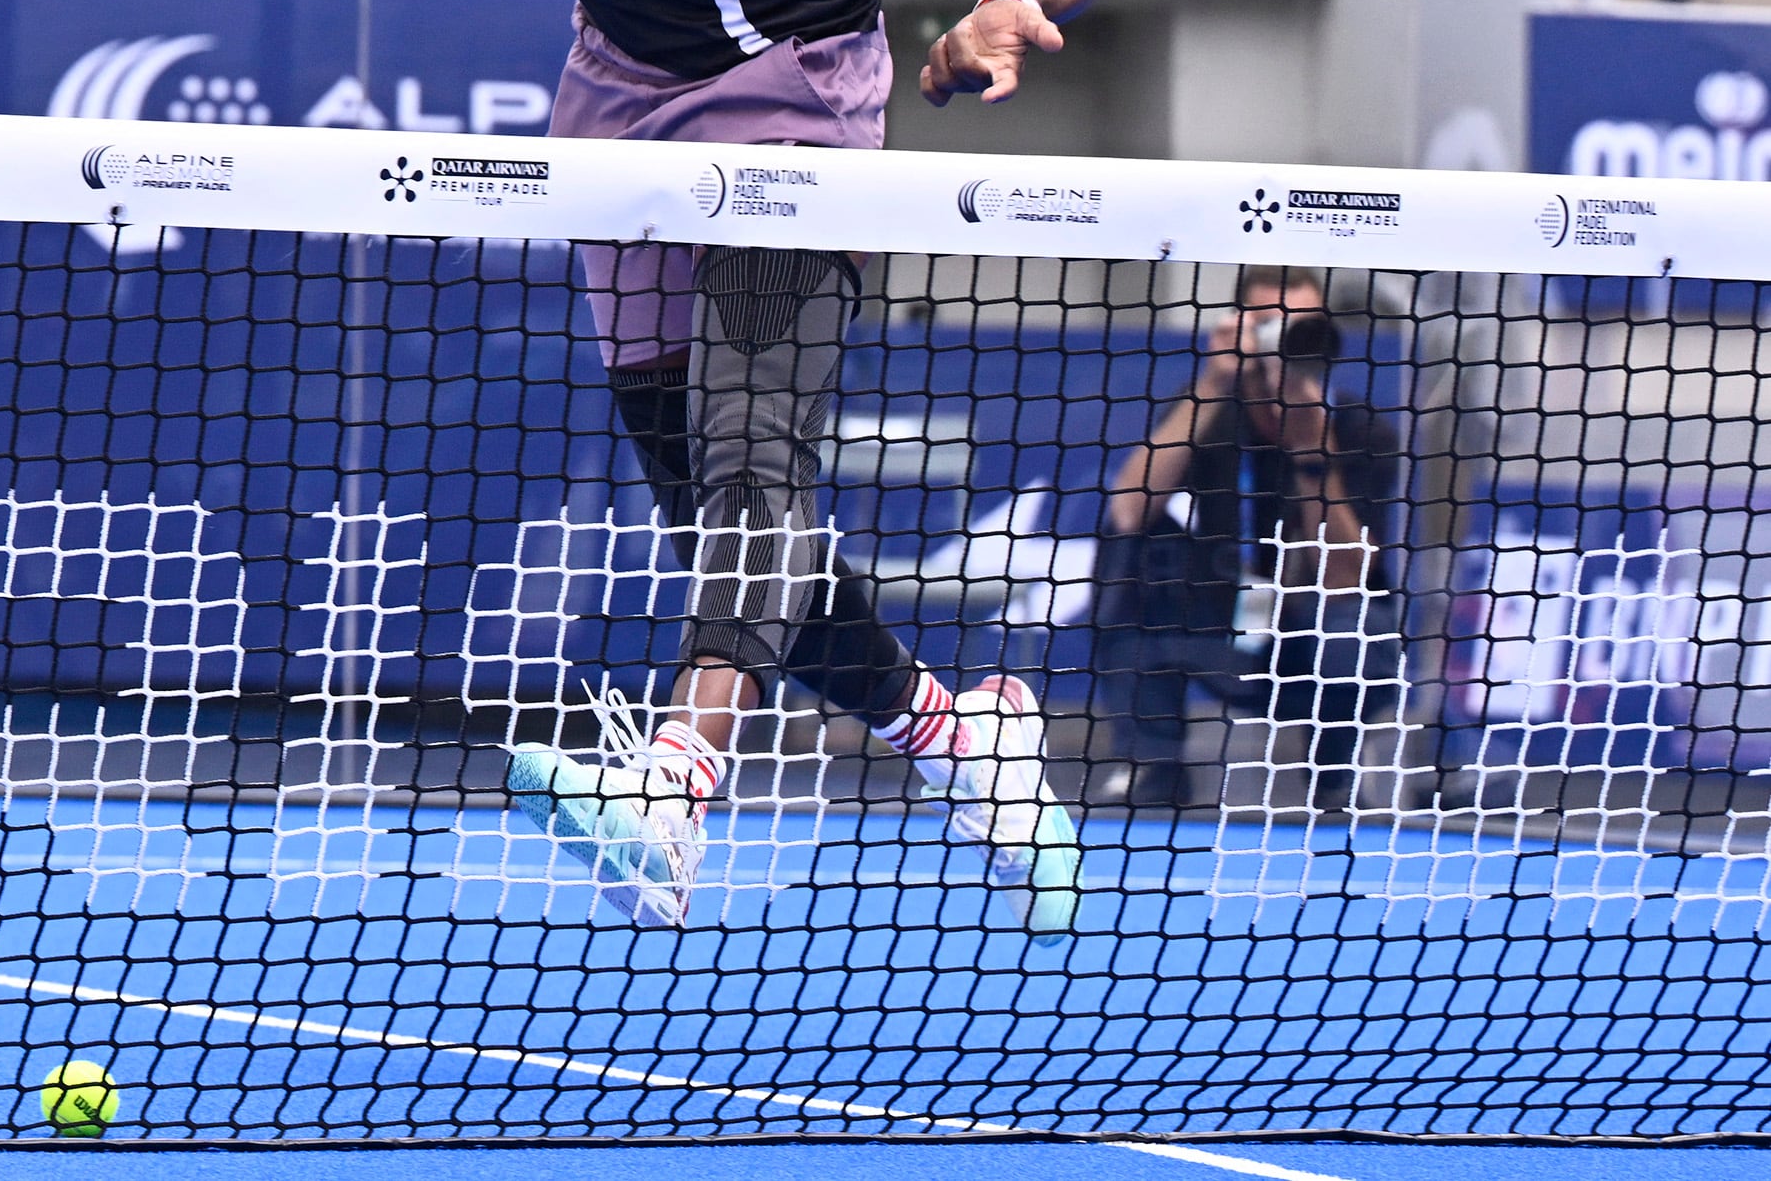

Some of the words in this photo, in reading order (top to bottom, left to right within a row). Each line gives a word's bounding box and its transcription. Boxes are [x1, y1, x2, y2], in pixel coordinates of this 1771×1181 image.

[135, 154, 234, 168] ALPINE
[433, 160, 483, 175] QATAR
[485, 162, 548, 177] AIRWAYS
[132, 165, 175, 180] PARIS
[179, 168, 234, 182] MAJOR
[734, 168, 819, 185] INTERNATIONAL
[141, 180, 192, 190] PREMIER
[195, 182, 232, 191] PADEL
[430, 180, 495, 193] PREMIER
[502, 183, 549, 195] PADEL
[733, 185, 766, 200] PADEL
[474, 197, 503, 206] TOUR
[1009, 188, 1102, 200] ALPINE
[1289, 192, 1338, 206] QATAR
[1340, 194, 1400, 209] AIRWAYS
[731, 201, 798, 217] FEDERATION
[1006, 199, 1046, 213] PARIS
[1050, 201, 1101, 214] MAJOR
[1577, 199, 1658, 216] INTERNATIONAL
[1015, 213, 1062, 222] PREMIER
[1066, 215, 1100, 224] PADEL
[1286, 212, 1349, 224] PREMIER
[1355, 214, 1399, 227] PADEL
[1576, 215, 1608, 230] PADEL
[1329, 228, 1356, 237] TOUR
[1574, 231, 1637, 246] FEDERATION
